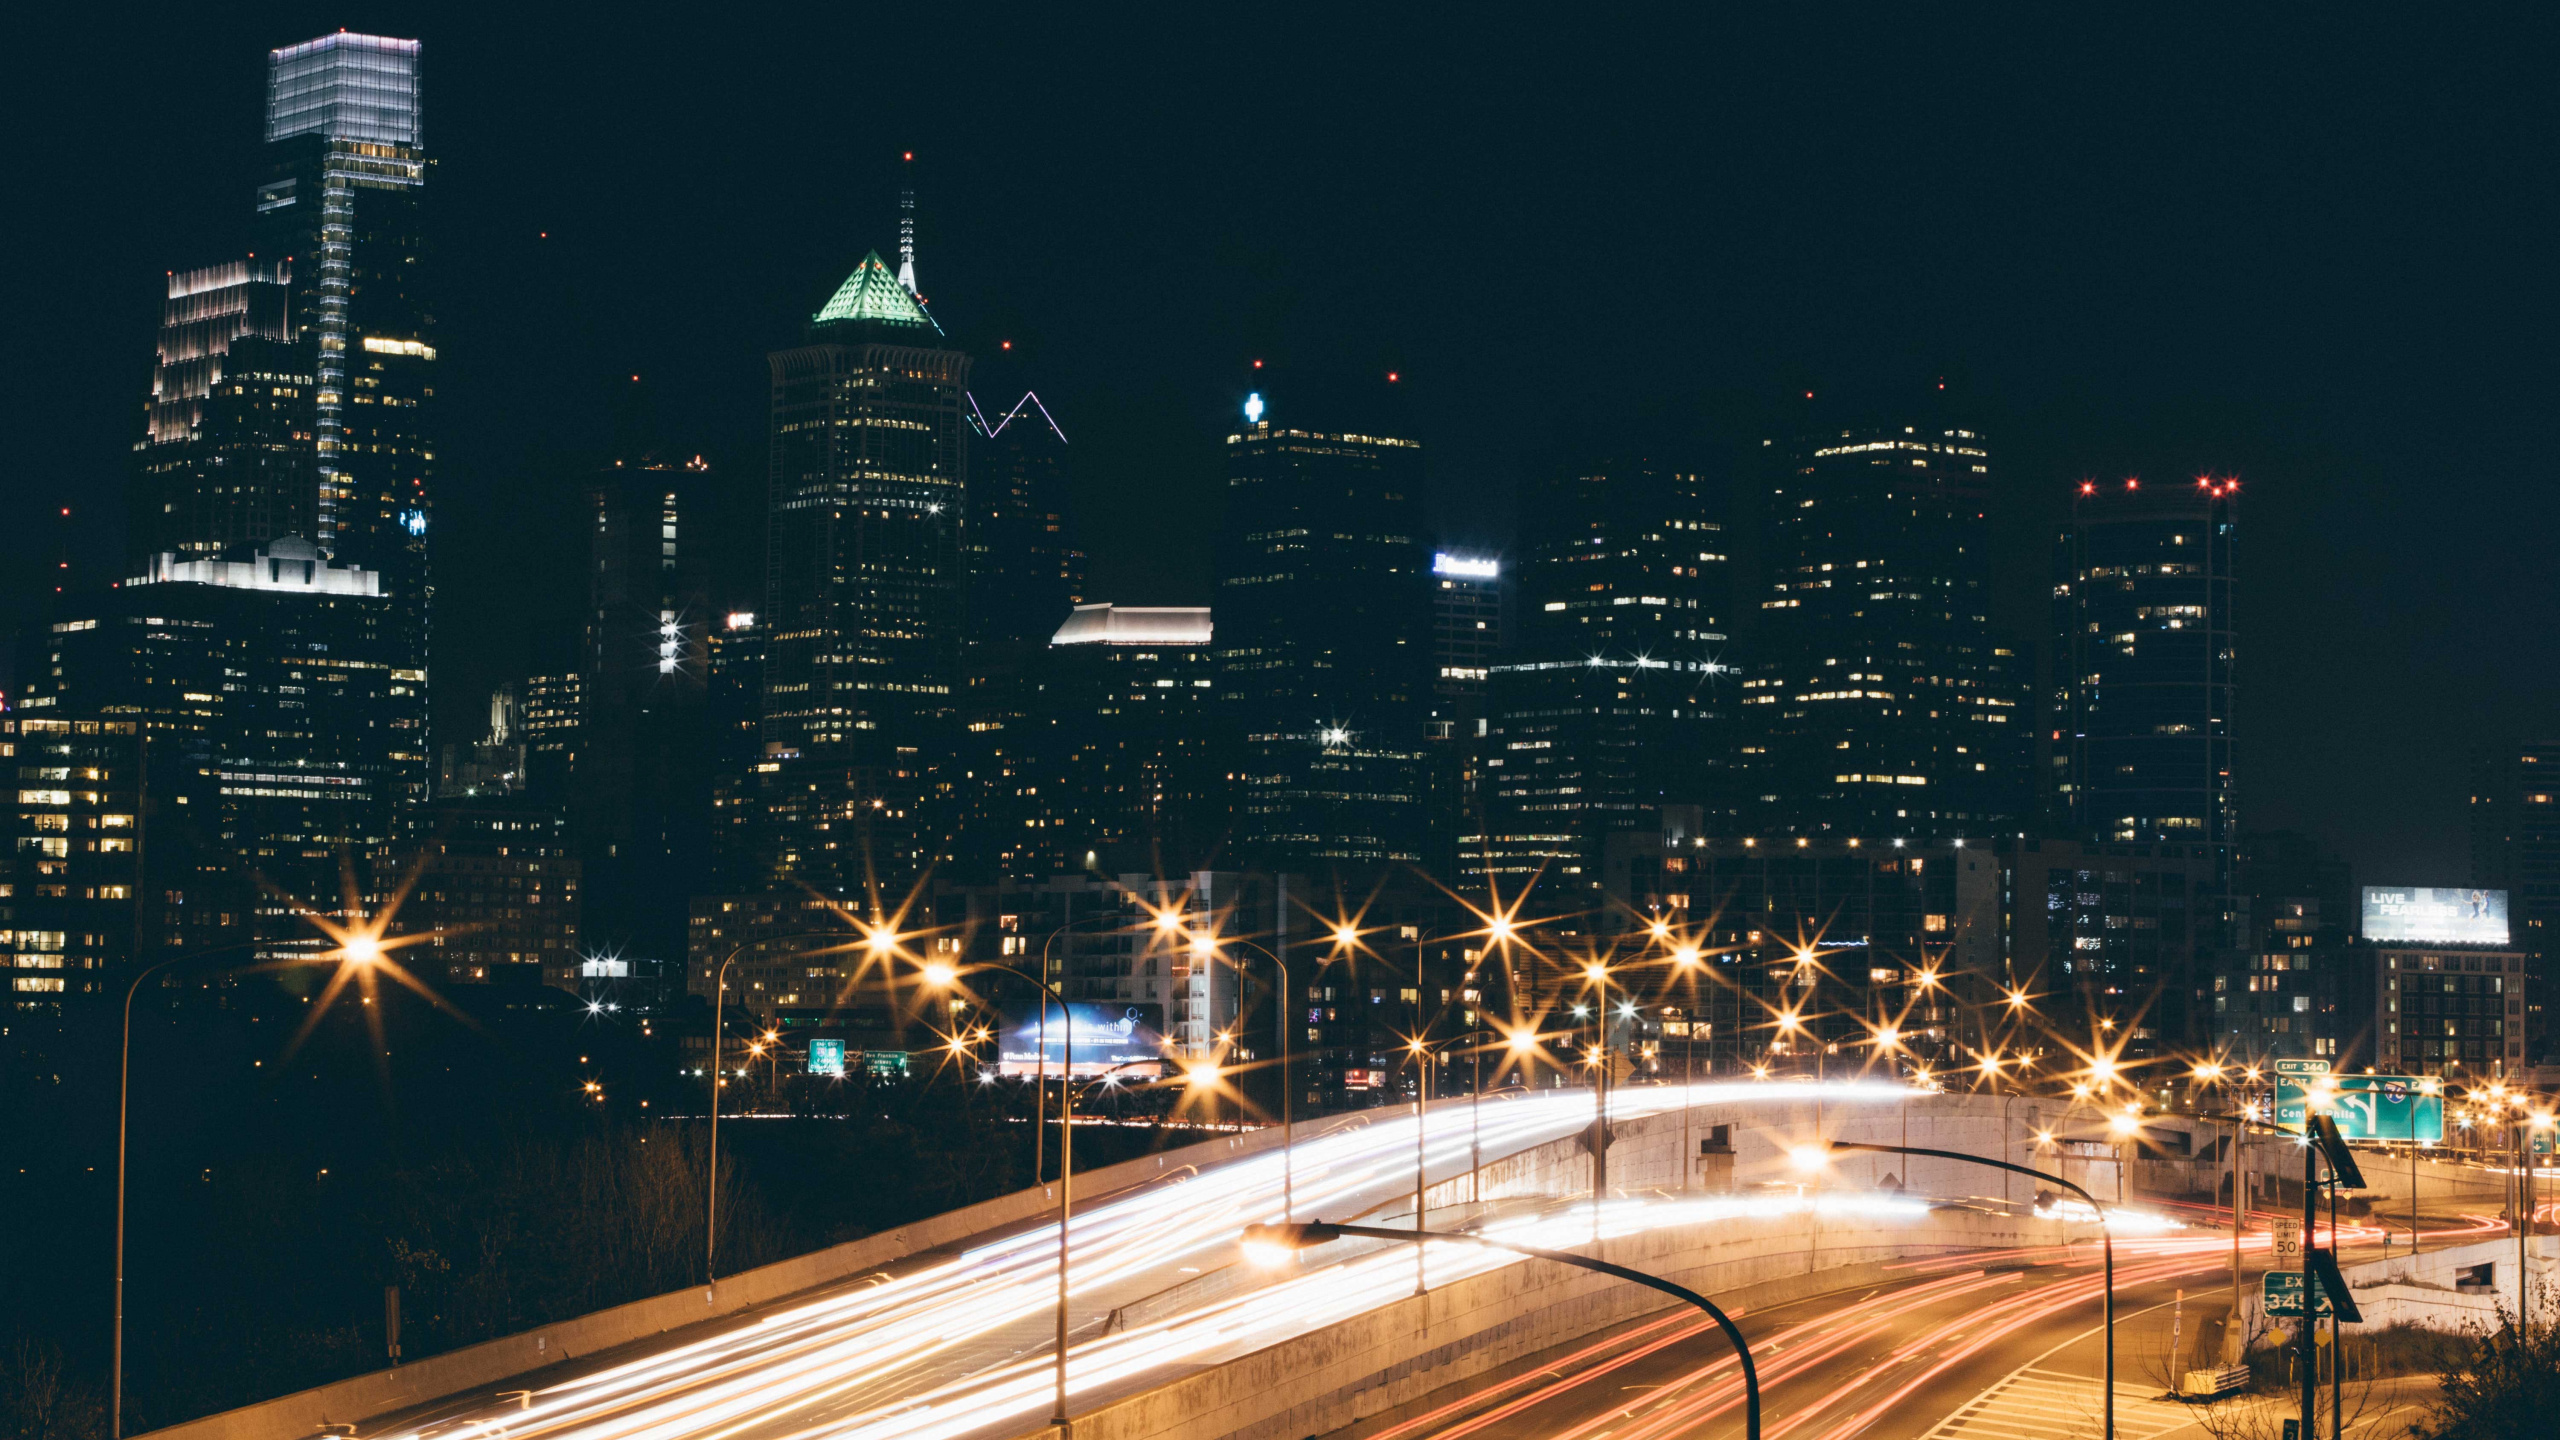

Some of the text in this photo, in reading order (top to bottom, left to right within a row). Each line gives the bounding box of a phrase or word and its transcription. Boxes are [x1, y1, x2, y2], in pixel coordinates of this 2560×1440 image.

[2371, 892, 2405, 904] LIVE
[2380, 904, 2458, 917] FEARLESS
[1097, 1021, 1129, 1032] within
[2302, 1062, 2324, 1072] 344
[2277, 1241, 2296, 1253] 50
